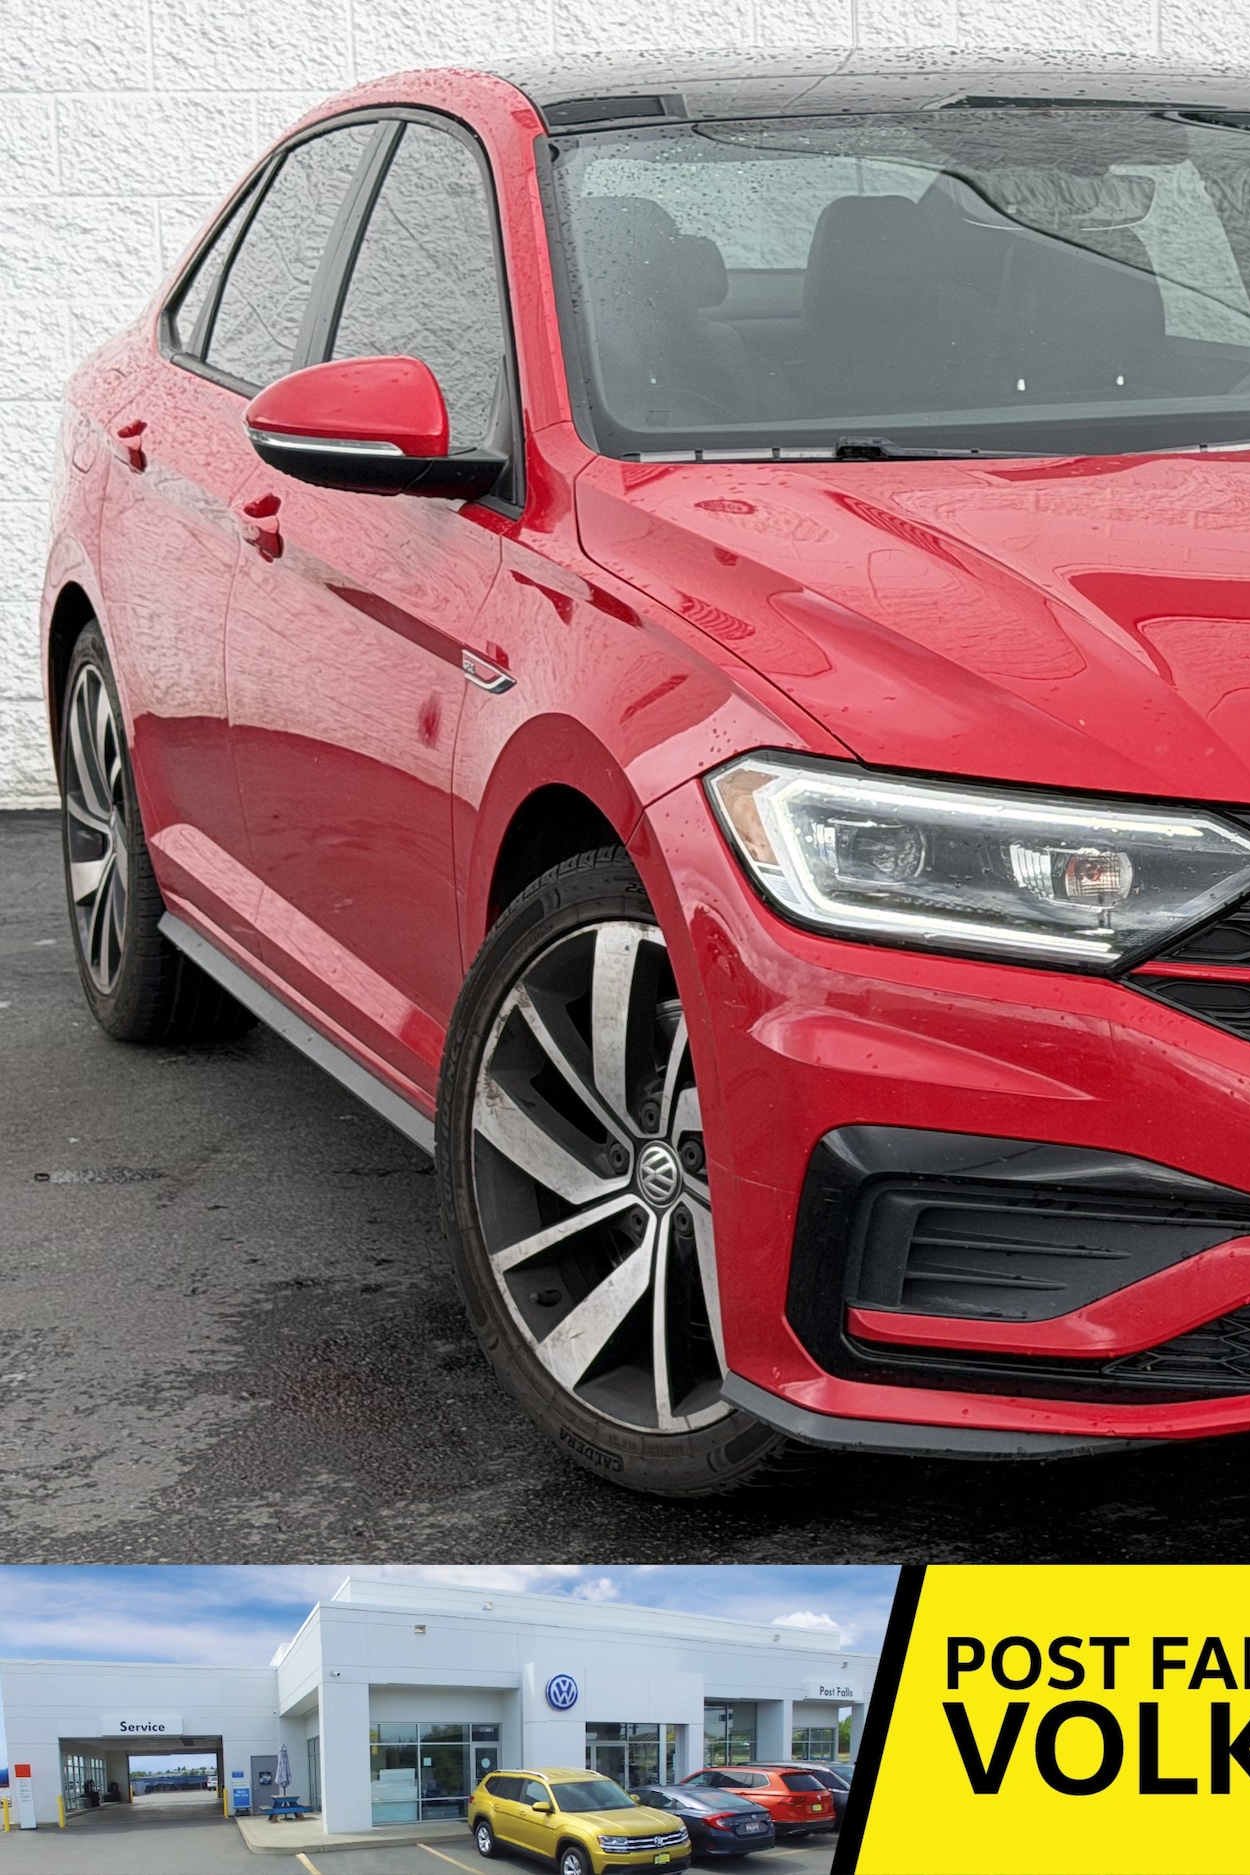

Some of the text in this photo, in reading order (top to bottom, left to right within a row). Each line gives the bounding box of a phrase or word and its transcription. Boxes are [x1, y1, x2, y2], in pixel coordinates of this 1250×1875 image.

[559, 1425, 625, 1472] CALDERA
[819, 1685, 854, 1698] Post Falls
[120, 1720, 166, 1732] Service
